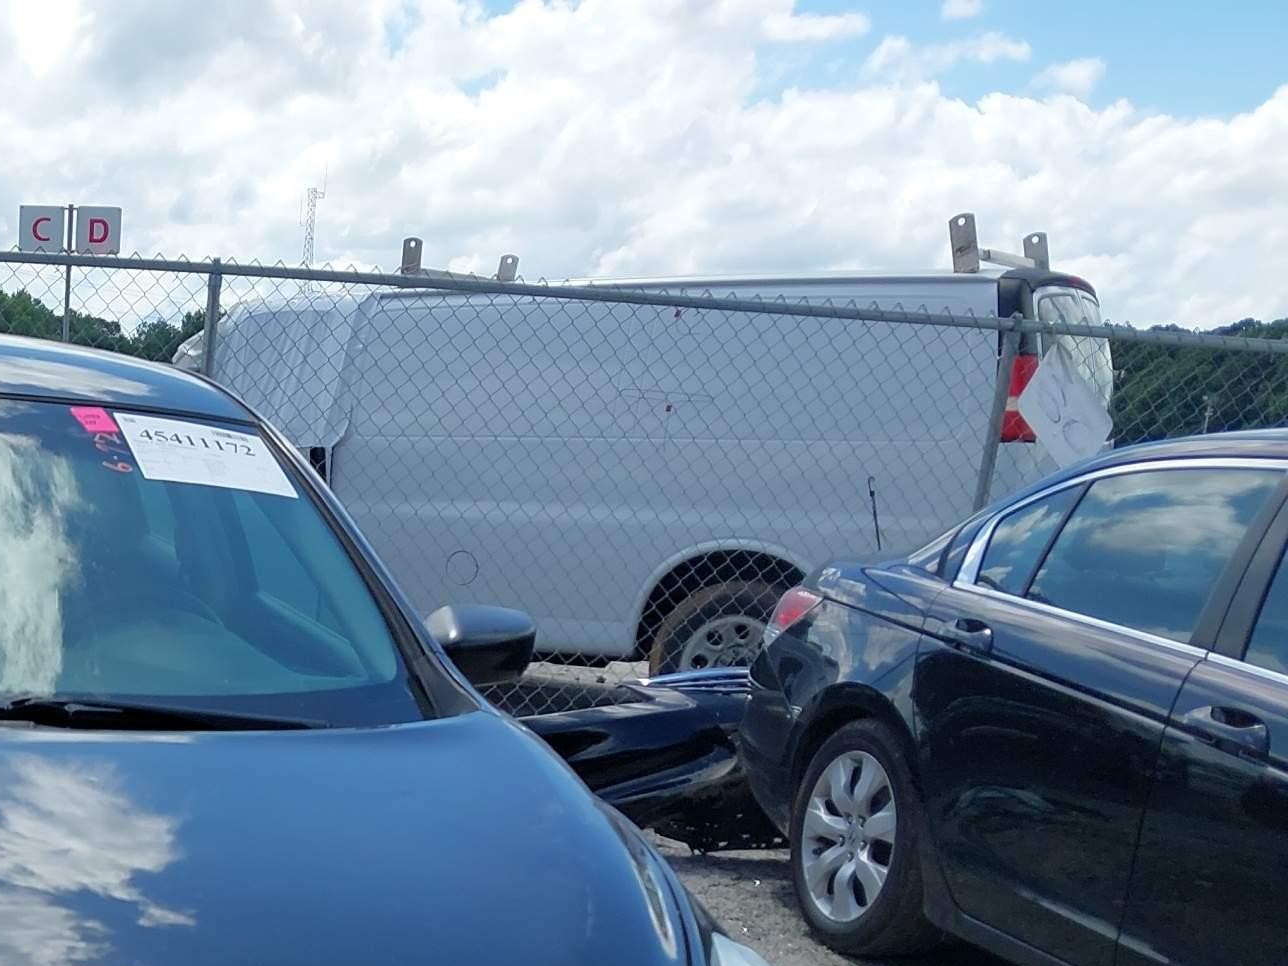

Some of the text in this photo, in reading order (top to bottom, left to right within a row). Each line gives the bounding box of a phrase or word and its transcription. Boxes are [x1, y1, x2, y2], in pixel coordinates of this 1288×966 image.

[32, 217, 51, 242] C
[88, 218, 110, 243] D
[139, 429, 256, 457] 45411172
